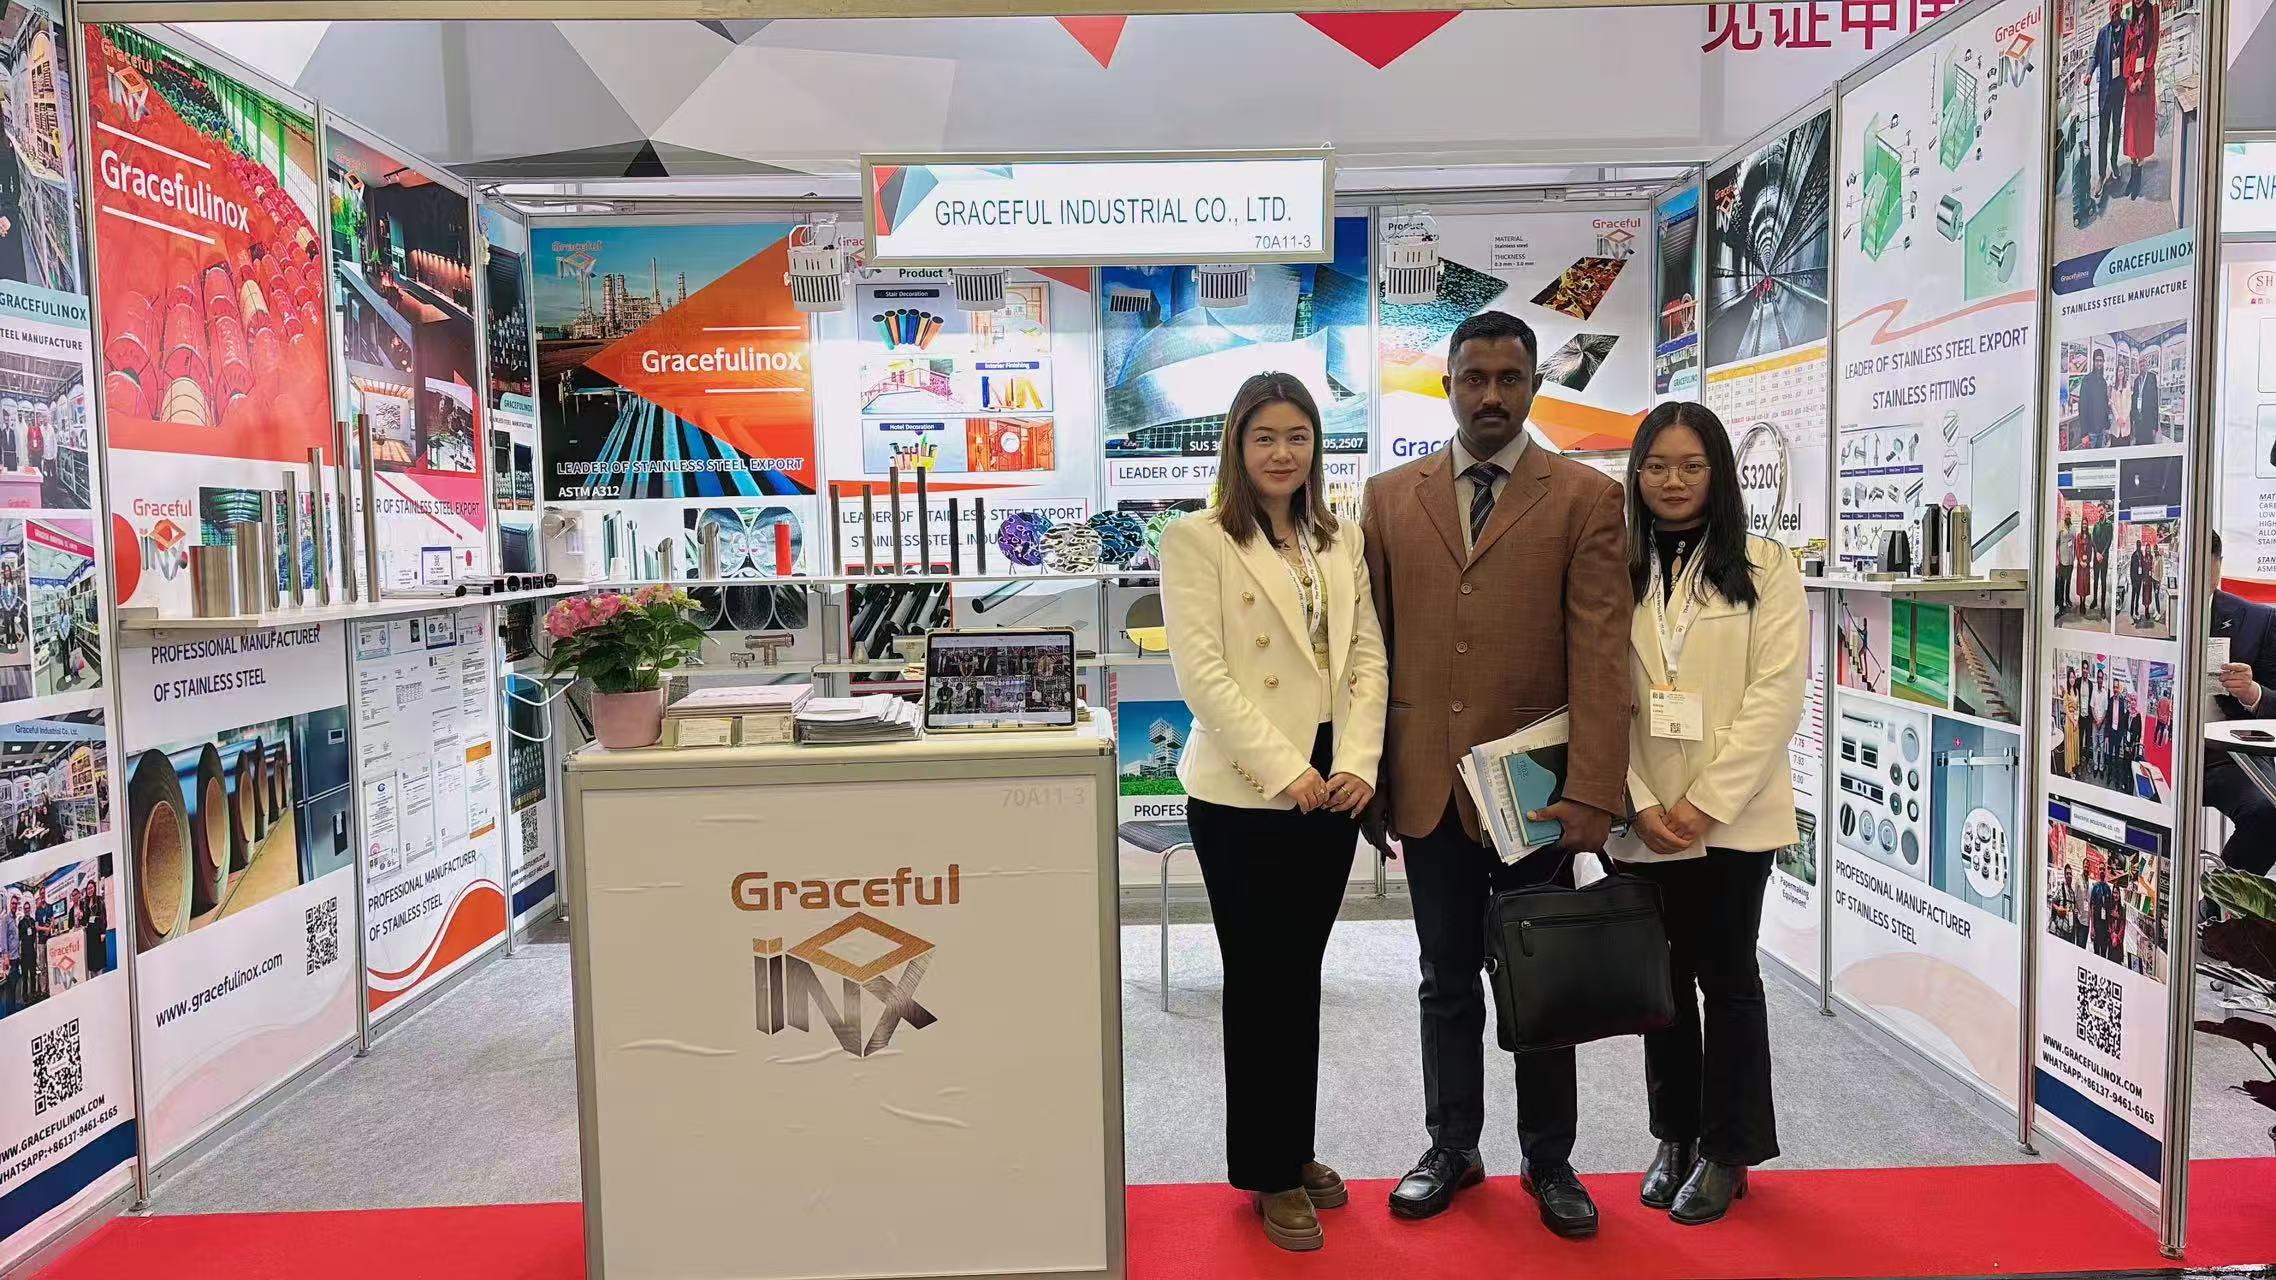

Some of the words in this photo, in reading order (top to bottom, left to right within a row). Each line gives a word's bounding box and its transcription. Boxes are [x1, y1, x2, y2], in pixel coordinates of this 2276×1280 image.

[1995, 6, 2041, 43] Graceful
[101, 38, 153, 74] Graceful
[101, 149, 250, 233] Gracefulinox
[935, 200, 1052, 225] GRACEFUL
[1060, 198, 1188, 224] INDUSTRIAL
[1195, 197, 1239, 226] CO.,
[1246, 196, 1292, 222] LTD.
[1592, 218, 1641, 228] Graceful
[1255, 235, 1311, 249] 70A11-3
[2108, 240, 2193, 275] GRACEFULINOX
[899, 268, 943, 278] Product
[0, 292, 87, 321] GRACEFULINOX
[2062, 299, 2101, 316] STAINLESS
[2102, 295, 2126, 308] STEEL
[2128, 280, 2187, 301] MANUFACTURE
[0, 328, 19, 341] TEEL
[21, 331, 83, 350] MANUFACTURE
[1845, 360, 1873, 379] LEADER
[1875, 356, 1889, 373] OF
[1892, 344, 1943, 370] STAINLESS
[1945, 337, 1976, 360] STEEL
[1979, 326, 2028, 352] EXPORT
[642, 347, 803, 373] Gracefulinox
[1872, 384, 1926, 410] STAINLESS
[1930, 376, 1976, 402] FITTINGS
[1189, 441, 1210, 451] SUS
[1322, 438, 1363, 449] 05,2507
[557, 461, 608, 475] LEADER
[611, 460, 631, 474] OF
[633, 460, 704, 474] STAINLESS
[707, 459, 748, 471] STEEL
[750, 458, 803, 470] EXPORT
[1119, 467, 1168, 479] LEADER
[1171, 467, 1189, 478] OF
[133, 498, 192, 517] Graceful
[384, 499, 394, 513] OF
[396, 499, 432, 515] STAINLESS
[435, 501, 454, 515] STEEL
[455, 502, 480, 515] EXPORT
[558, 487, 591, 498] ASTM
[592, 486, 621, 497] A312
[152, 637, 238, 664] PROFESSIONAL
[241, 627, 320, 653] MANUFACTURER
[154, 682, 170, 702] OF
[173, 672, 234, 699] STAINLESS
[236, 668, 266, 688] STEEL
[368, 875, 424, 912] PROFESSIONAL
[425, 850, 476, 885] MANUFACTURER
[731, 864, 960, 912] Graceful
[1836, 859, 1893, 900] PROFESSIONAL
[1896, 888, 1971, 939] MANUFACTURER
[369, 924, 380, 942] OF
[382, 903, 421, 935] STAINLESS
[422, 894, 443, 914] STEEL
[1836, 889, 1846, 907] OF
[1848, 896, 1889, 930] STAINLESS
[1892, 918, 1917, 945] STEEL
[156, 953, 283, 1028] www.gracefulinox.com
[2043, 1033, 2143, 1099] WWW.GRACEFULINOX.COM
[2042, 1050, 2155, 1125] WHATSAPP:+86137-9461-6165
[0, 1094, 105, 1164] WW.GRACEFULINOX.COM
